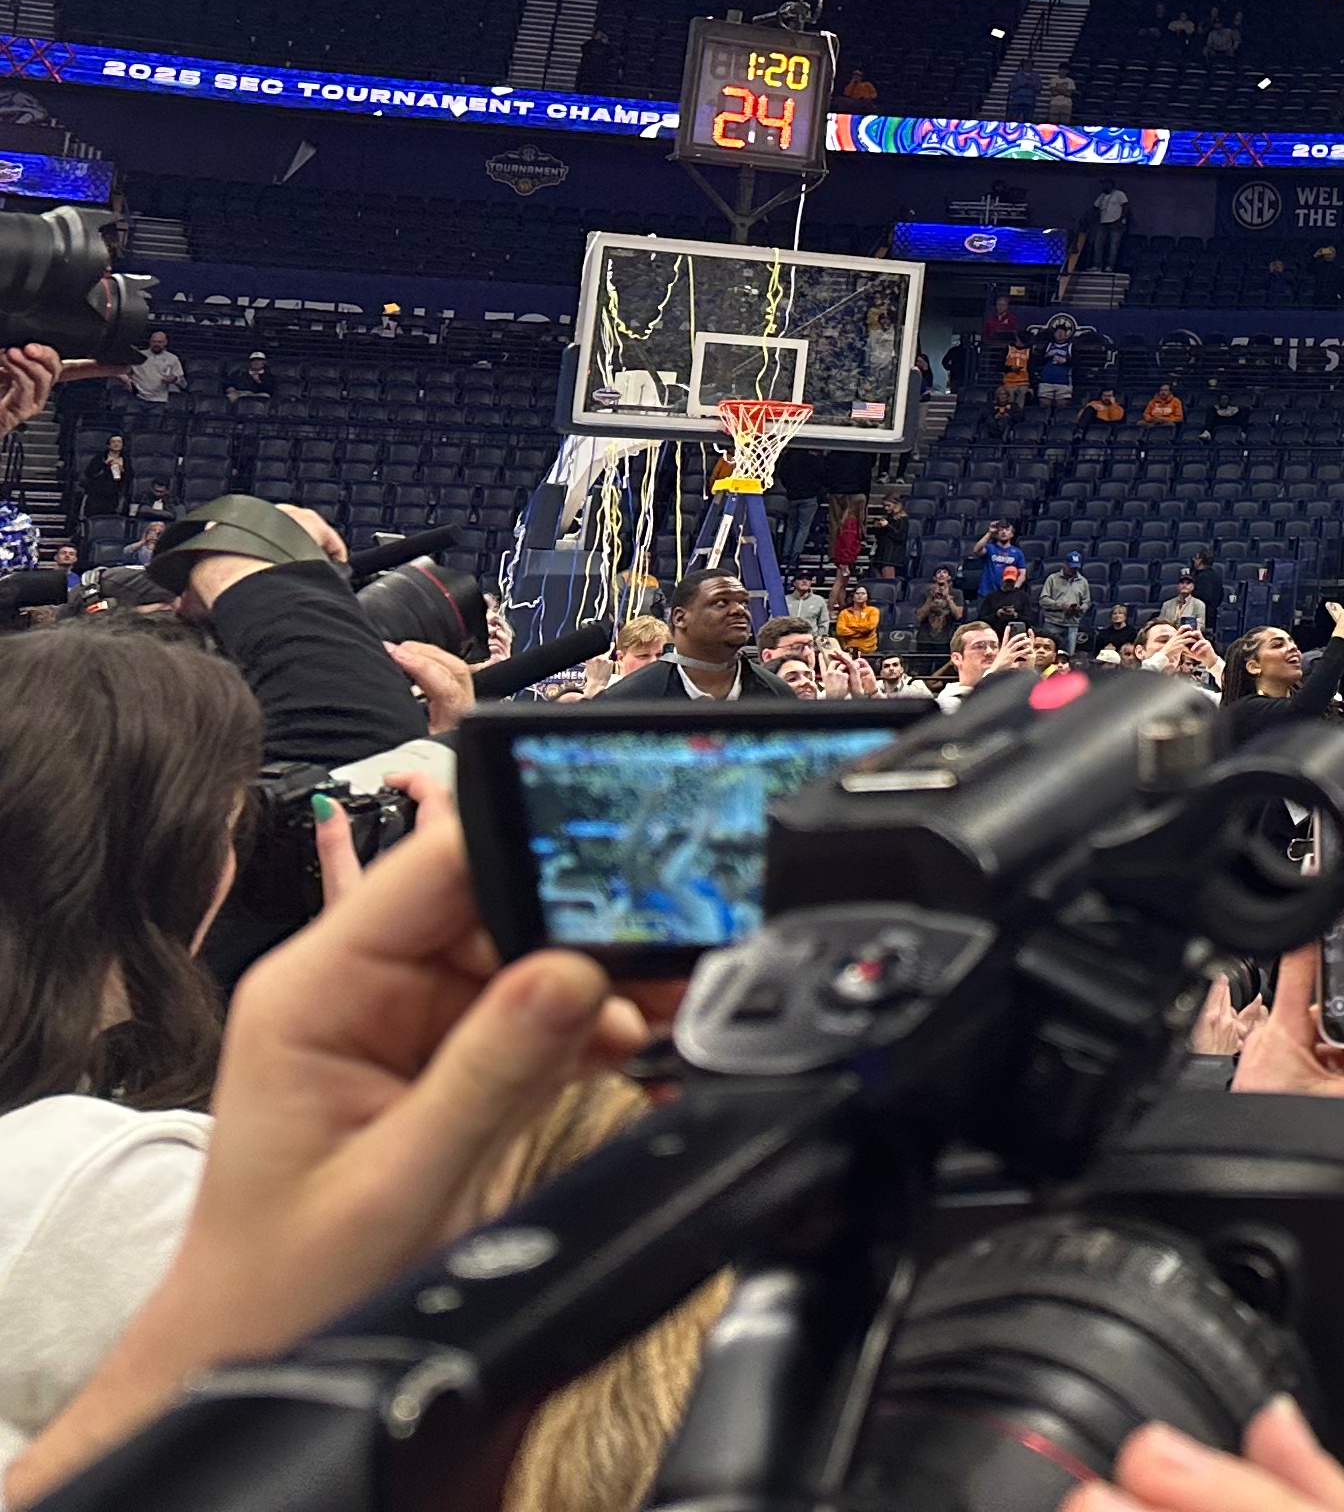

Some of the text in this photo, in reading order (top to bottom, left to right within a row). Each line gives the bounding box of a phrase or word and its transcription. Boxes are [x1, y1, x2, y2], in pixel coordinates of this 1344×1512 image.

[102, 60, 201, 86] 2025
[214, 73, 284, 94] SEC
[297, 82, 535, 118] TOURNAMENT
[747, 51, 811, 91] 1:20
[712, 85, 796, 150] 24
[488, 161, 567, 178] TOURNAMENT
[1236, 184, 1278, 226] SEC
[1296, 208, 1337, 228] THE
